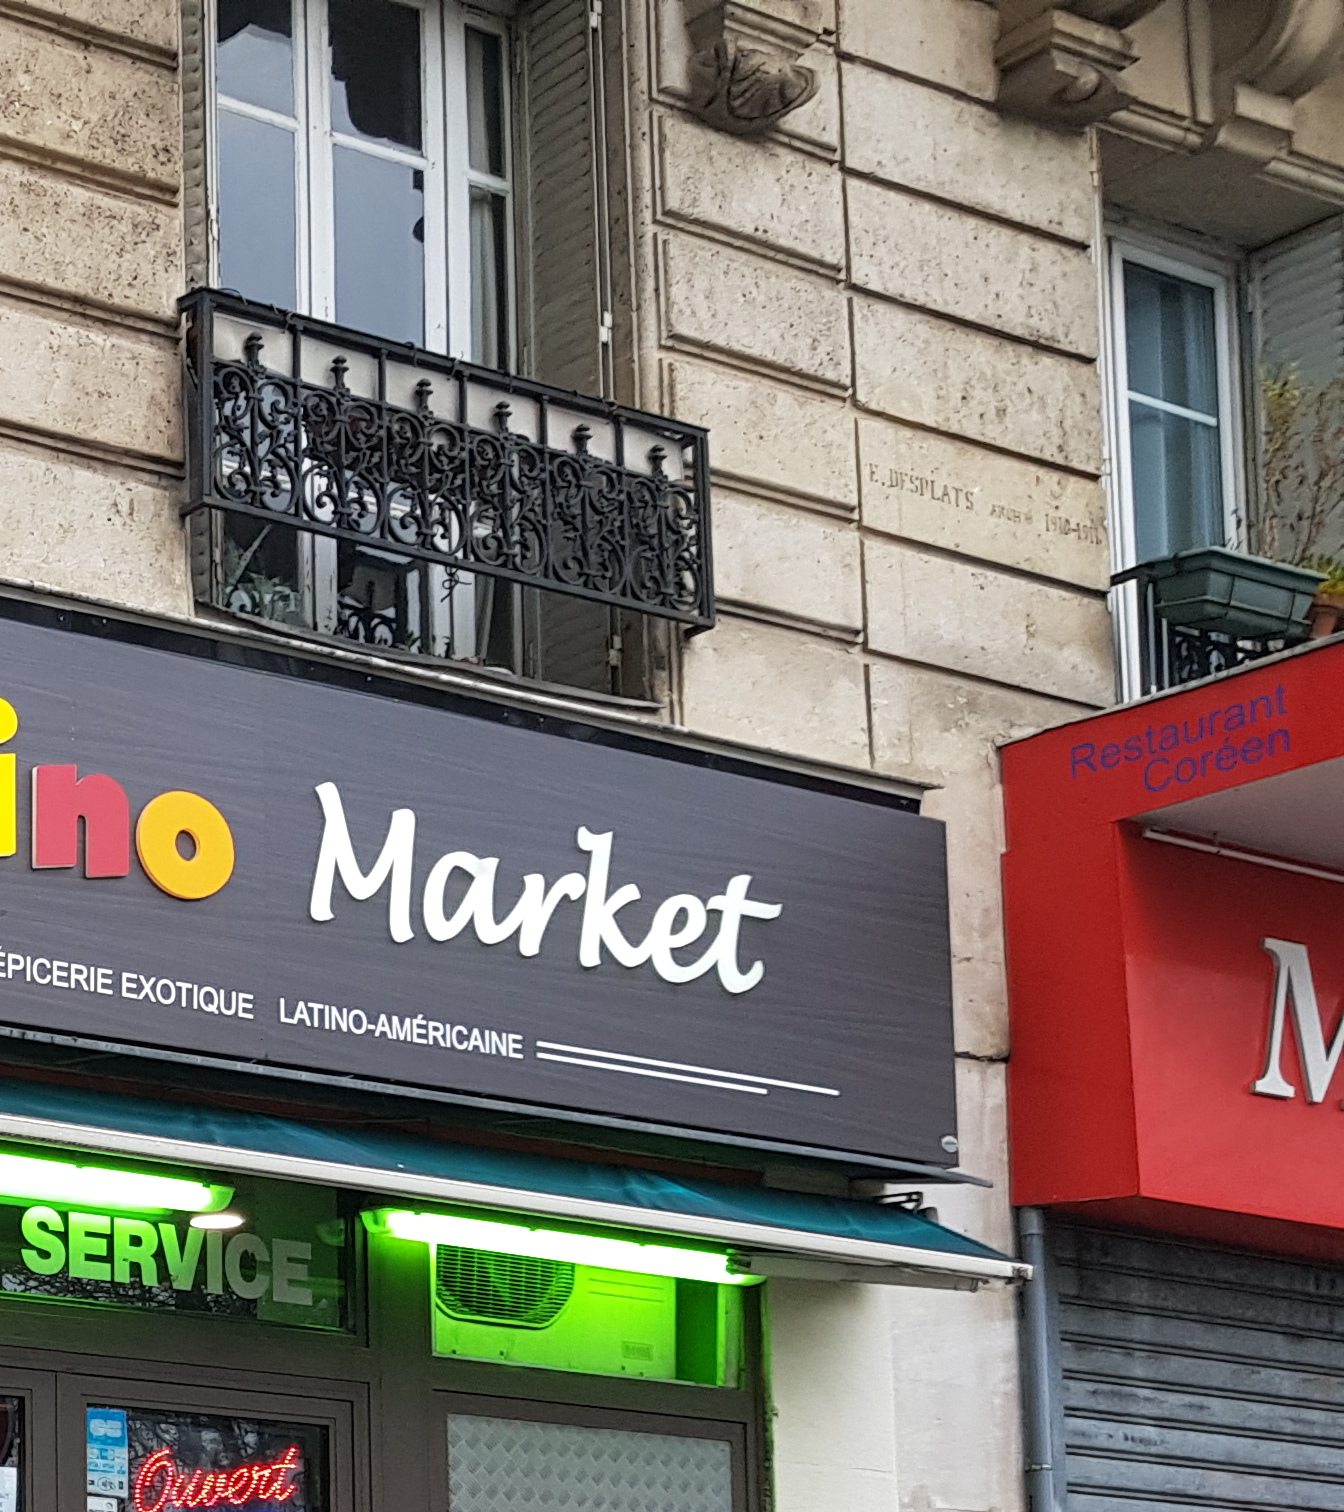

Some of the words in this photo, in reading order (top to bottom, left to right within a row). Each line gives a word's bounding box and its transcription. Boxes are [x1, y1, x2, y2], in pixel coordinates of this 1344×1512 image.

[1071, 684, 1287, 779] Restaurant
[1143, 728, 1290, 792] Coréen
[310, 780, 783, 994] Market
[121, 973, 254, 1019] EXOTIQUE
[279, 997, 524, 1059] LATINO-AMÉRICAINE
[20, 1205, 313, 1306] SERVICE
